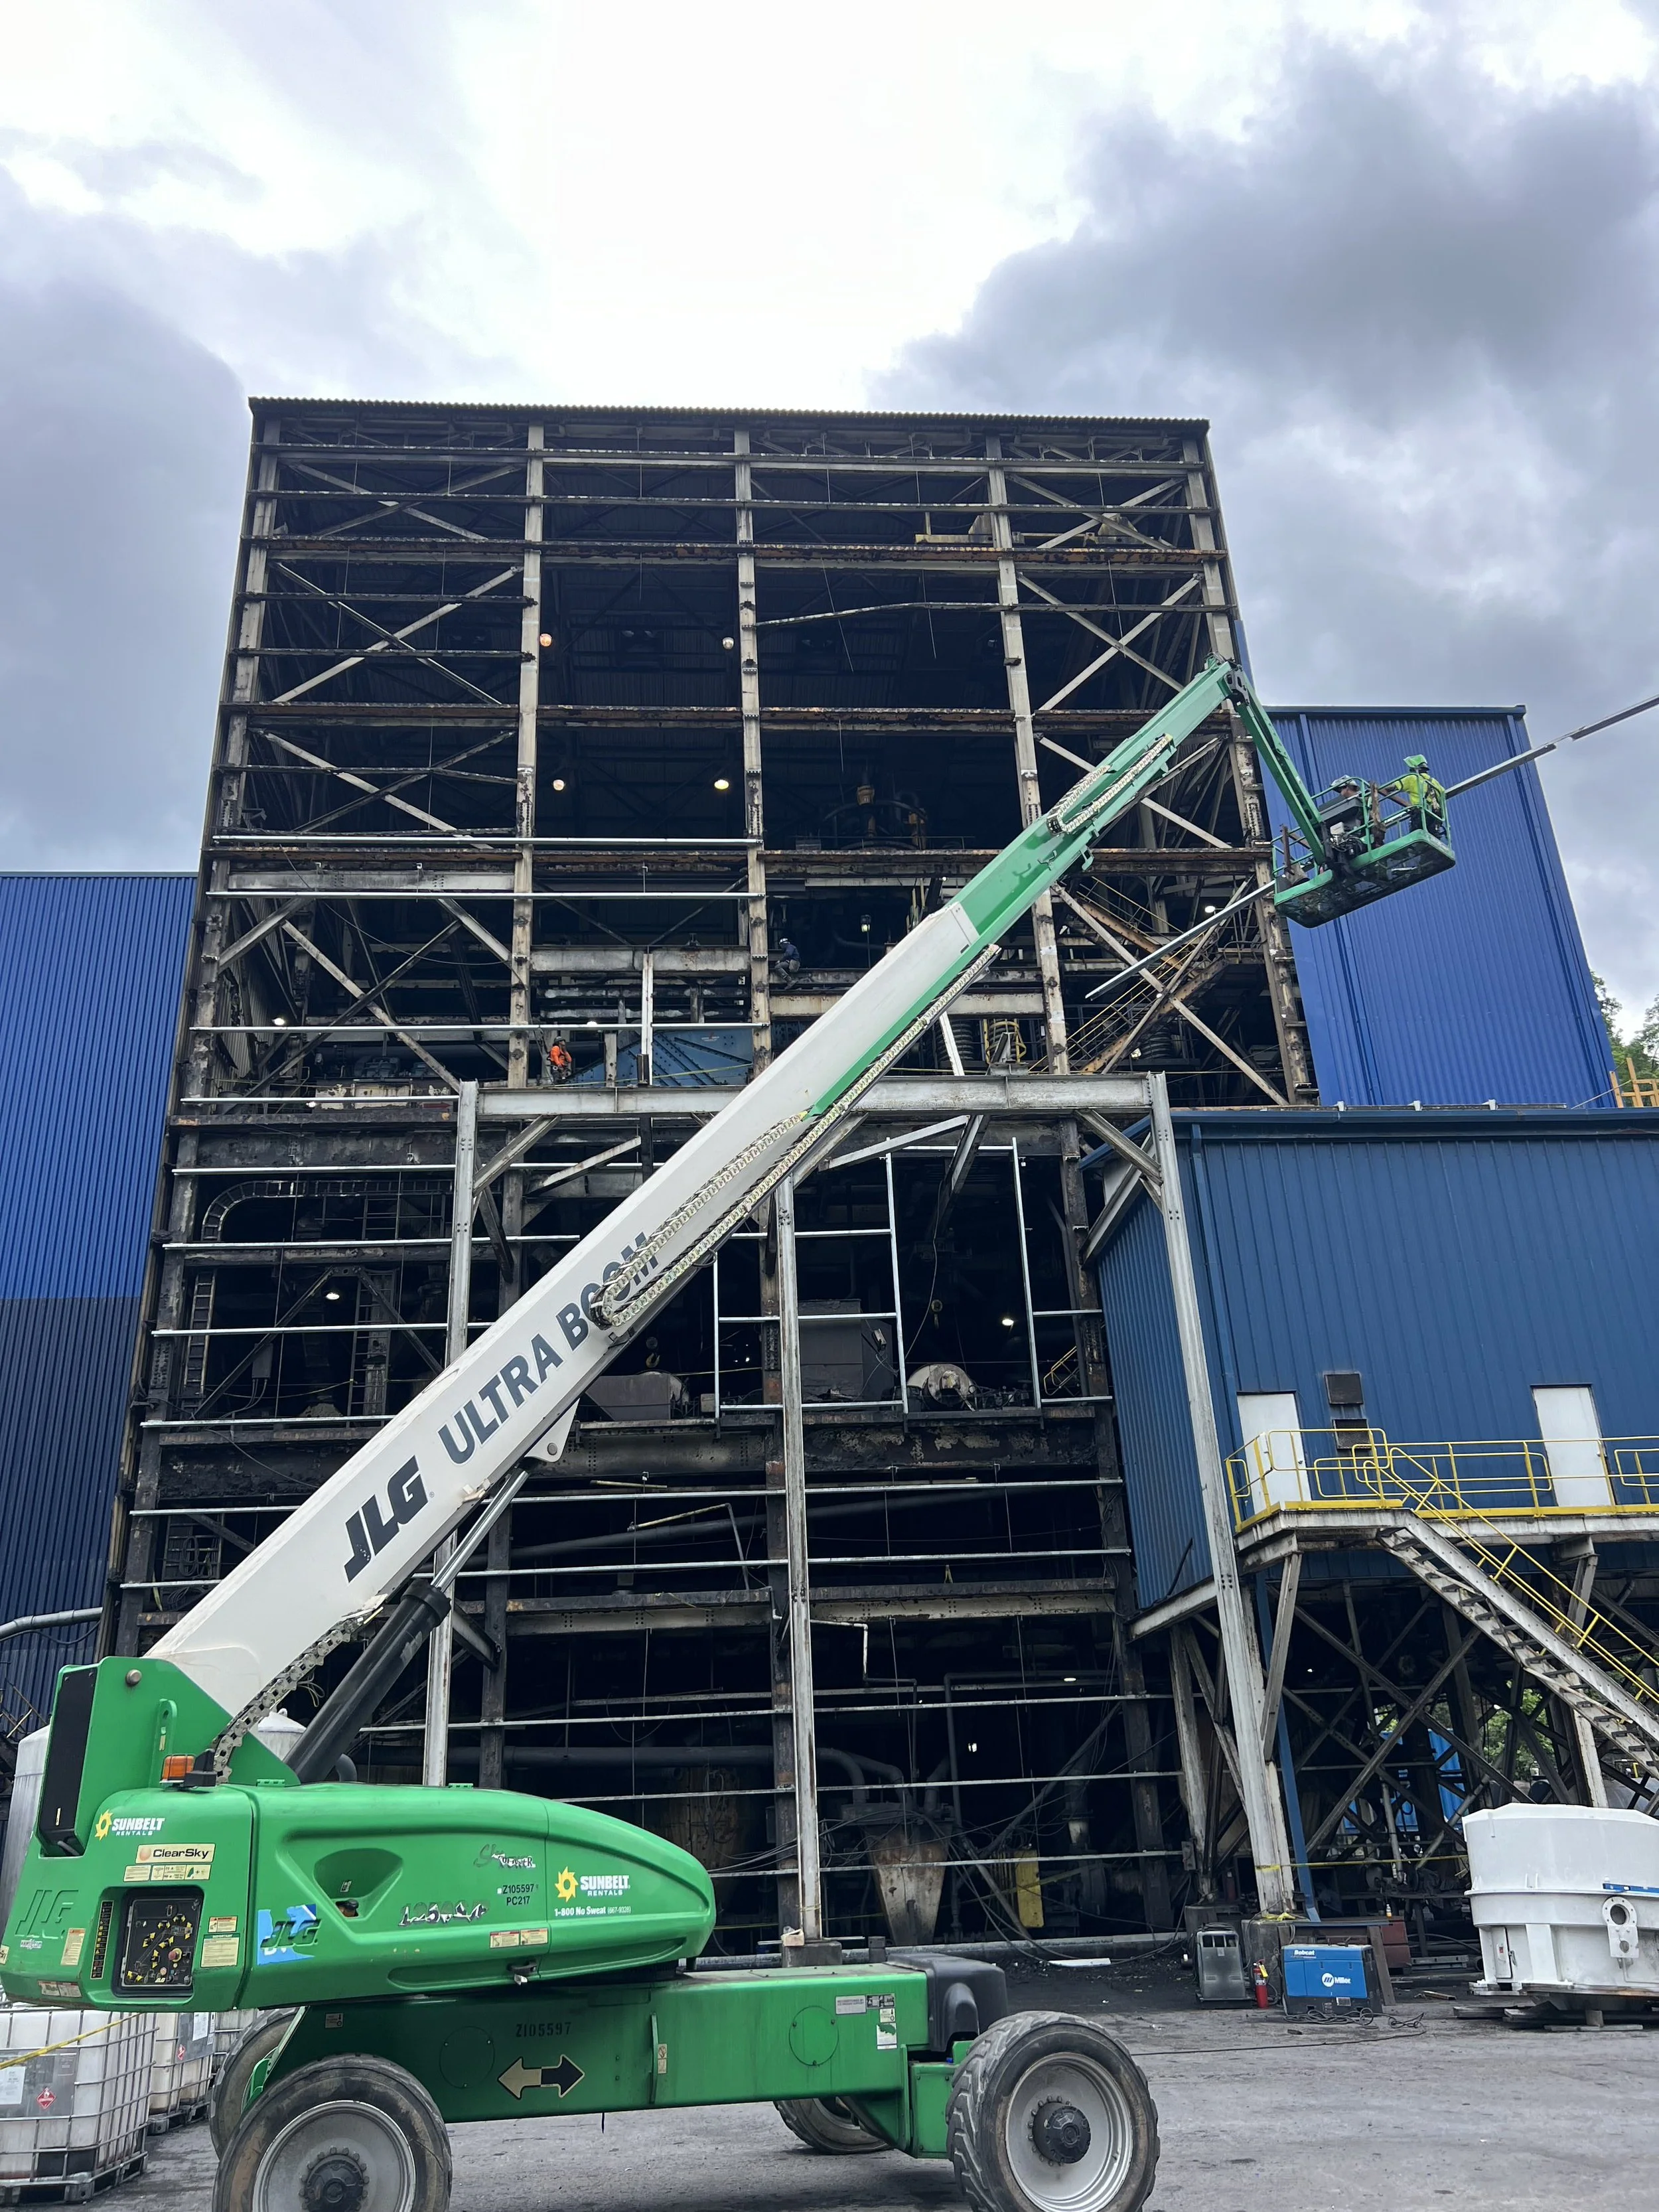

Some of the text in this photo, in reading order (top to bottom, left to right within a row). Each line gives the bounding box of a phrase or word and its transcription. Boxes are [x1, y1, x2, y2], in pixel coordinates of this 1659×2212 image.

[344, 1455, 429, 1584] JLG
[437, 1333, 564, 1465] ULTRA
[111, 1817, 165, 1831] SUNBELT
[153, 1848, 210, 1859] ClearSky
[502, 1883, 534, 1894] Z105597
[580, 1875, 630, 1890] SUNBELT
[506, 1895, 530, 1906] PC217
[554, 1907, 575, 1917] 1-800
[575, 1906, 585, 1915] No
[586, 1905, 607, 1915] Sweat
[516, 2022, 571, 2037] Z105597
